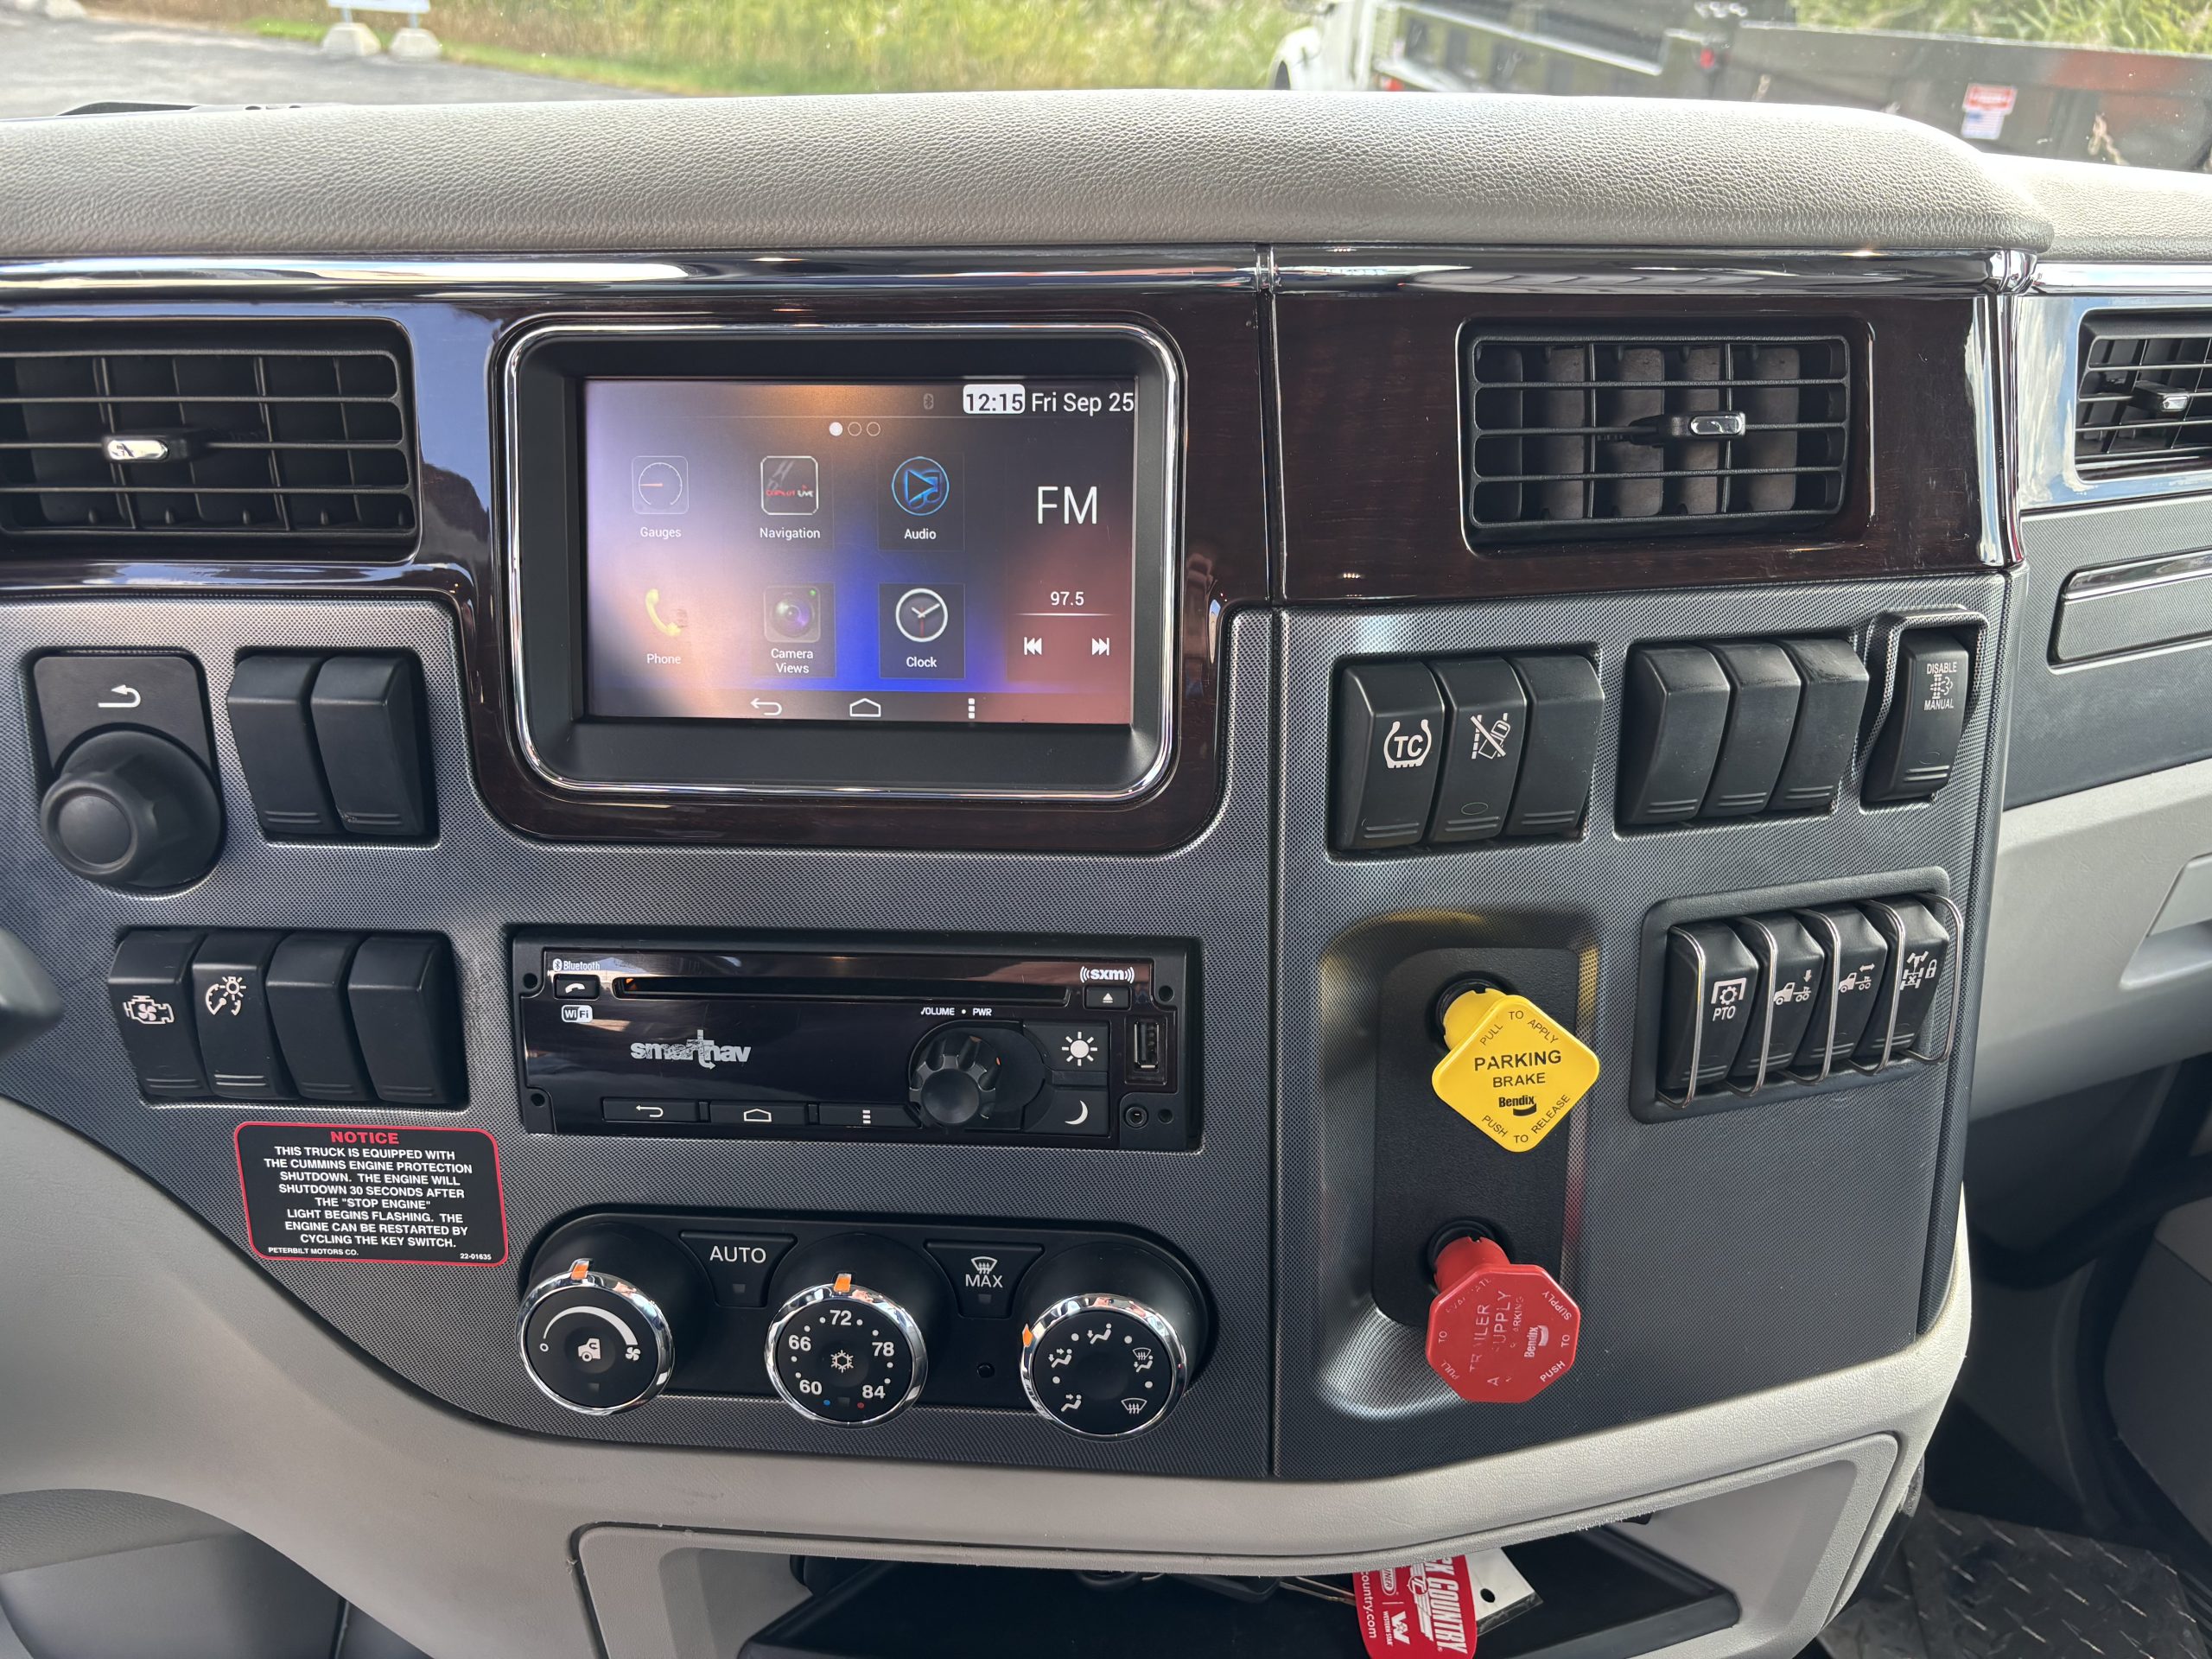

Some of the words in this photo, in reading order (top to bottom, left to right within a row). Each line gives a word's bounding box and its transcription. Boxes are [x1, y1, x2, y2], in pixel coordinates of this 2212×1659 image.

[966, 393, 1024, 412] 12:15
[1032, 392, 1057, 412] Fri
[1063, 393, 1103, 416] Sep
[1109, 393, 1135, 412] 25
[1038, 486, 1097, 524] FM
[639, 526, 682, 540] Gauges
[760, 527, 821, 541] Navigation
[904, 528, 937, 540] Audio
[1050, 591, 1084, 607] 97.5
[646, 652, 681, 665] Phone
[771, 647, 813, 659] Camera
[776, 662, 810, 674] Views
[906, 656, 938, 668] Clock
[1927, 662, 1957, 674] DISABLE
[1924, 698, 1954, 710] MANUAL
[1394, 734, 1423, 758] TC
[563, 961, 601, 972] Bluetooth
[973, 1007, 992, 1016] PWR
[1712, 1006, 1736, 1021] PTO
[1479, 1023, 1503, 1046] PULL
[1509, 1010, 1523, 1020] TO
[1528, 1020, 1559, 1044] APPLY
[1474, 1050, 1561, 1071] PARKING
[1492, 1072, 1546, 1088] BRAKE
[1499, 1095, 1535, 1108] Bendix
[1482, 1116, 1509, 1137] PUSH
[1531, 1094, 1571, 1134] RELEASE
[331, 1131, 399, 1145] NOTICE
[275, 1147, 302, 1156] THIS
[304, 1147, 345, 1157] TRUCK
[348, 1148, 359, 1158] IS
[363, 1148, 423, 1160] EQUIPPED
[425, 1150, 455, 1160] WITH
[264, 1159, 288, 1168] THE
[290, 1159, 346, 1170] CUMMINS
[349, 1160, 393, 1171] ENGINE
[397, 1162, 472, 1173] PROTECTION
[280, 1171, 352, 1183] SHUTDOWN.
[358, 1173, 381, 1183] THE
[385, 1174, 429, 1185] ENGINE
[431, 1176, 461, 1185] WILL
[279, 1184, 347, 1195] SHUTDOWN
[350, 1185, 363, 1195] 30
[365, 1186, 423, 1198] SECONDS
[427, 1188, 464, 1198] AFTER
[315, 1198, 339, 1207] THE
[342, 1198, 378, 1208] "STOP
[382, 1199, 430, 1209] ENGINE"
[287, 1209, 321, 1218] LIGHT
[325, 1210, 369, 1220] BEGINS
[372, 1211, 434, 1222] FLASHING.
[440, 1213, 463, 1223] THE
[285, 1221, 329, 1231] ENGINE
[332, 1223, 357, 1232] CAN
[360, 1224, 376, 1233] BE
[380, 1224, 449, 1235] RESTARTED
[453, 1226, 467, 1236] BY
[300, 1234, 352, 1245] CYCLING
[355, 1236, 378, 1245] THE
[381, 1236, 404, 1246] KEY
[407, 1236, 455, 1248] SWITCH.
[709, 1246, 766, 1263] AUTO
[965, 1274, 1002, 1288] MAX
[1542, 1290, 1572, 1320] SUPPLY
[830, 1310, 852, 1325] 72
[1492, 1290, 1511, 1352] UPPLY
[1513, 1296, 1524, 1332] ARKING
[789, 1335, 811, 1351] 66
[1438, 1332, 1447, 1343] TO
[1524, 1326, 1539, 1357] Bendix
[1561, 1334, 1570, 1347] TO
[872, 1342, 894, 1357] 78
[1540, 1361, 1566, 1382] PUSH
[799, 1380, 822, 1395] 60
[862, 1385, 886, 1400] 84
[1382, 1611, 1391, 1632] WESTERN
[1428, 1577, 1467, 1654] COUNTRY
